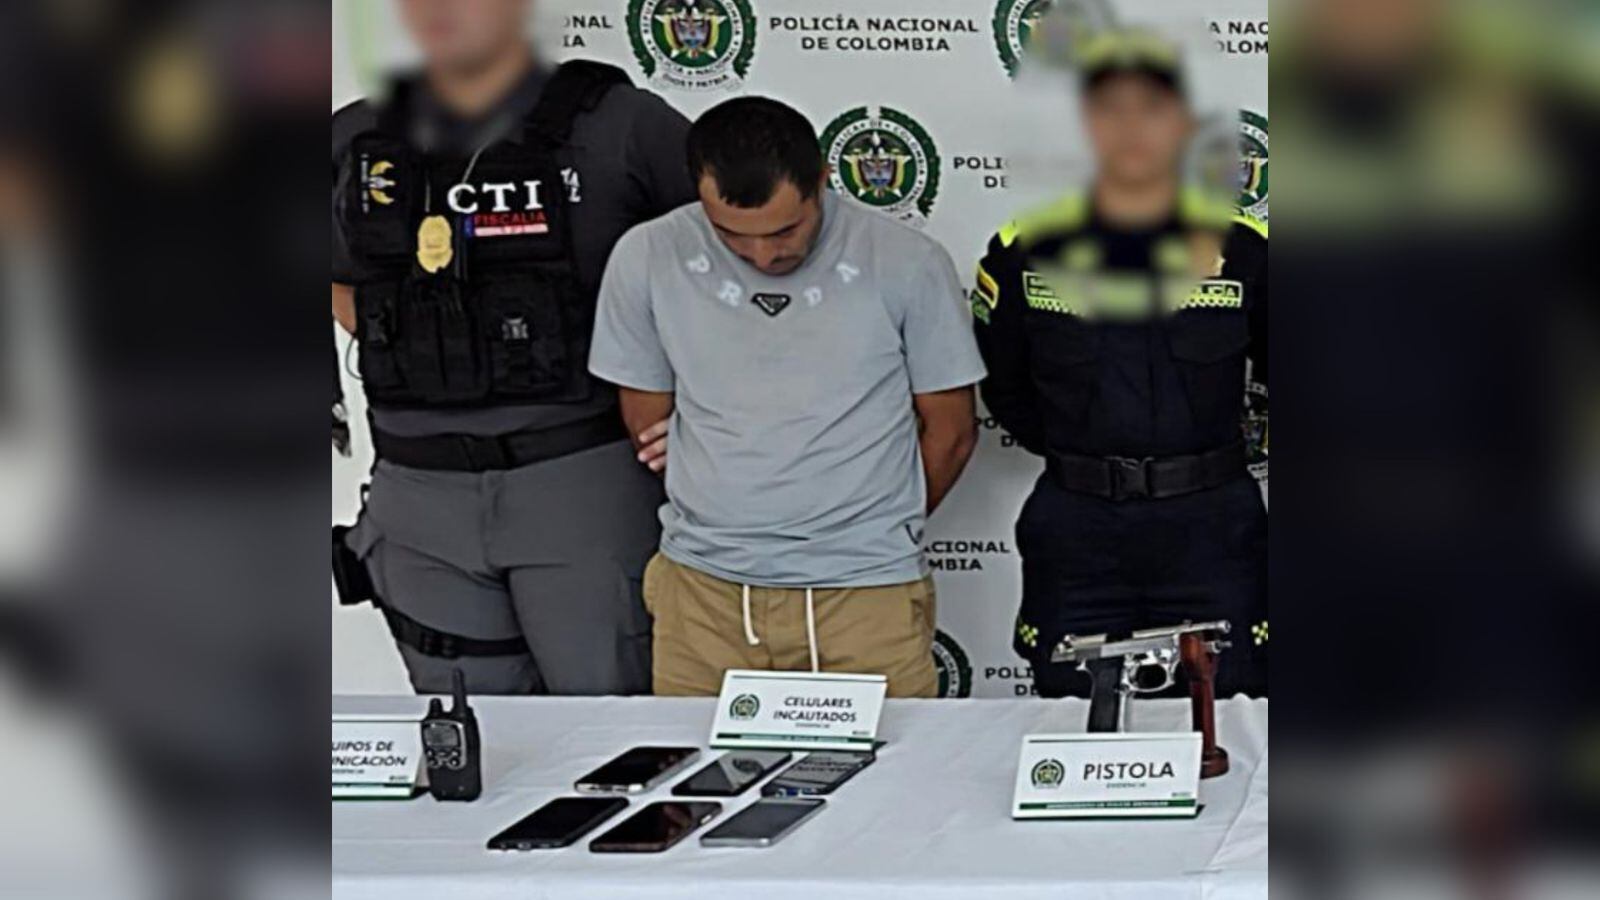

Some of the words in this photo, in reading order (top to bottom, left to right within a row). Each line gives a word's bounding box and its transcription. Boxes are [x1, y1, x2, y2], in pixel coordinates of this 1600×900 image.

[769, 14, 859, 31] POLICÍA
[866, 18, 979, 33] NACIONAL
[802, 36, 829, 50] DE
[836, 37, 951, 52] COLOMBIA
[953, 156, 1003, 170] POLI
[447, 180, 544, 214] CTI
[784, 696, 853, 709] CELULARES
[773, 711, 857, 723] INCAUTADOS
[377, 741, 394, 751] DE
[1083, 762, 1175, 781] PISTOLA
